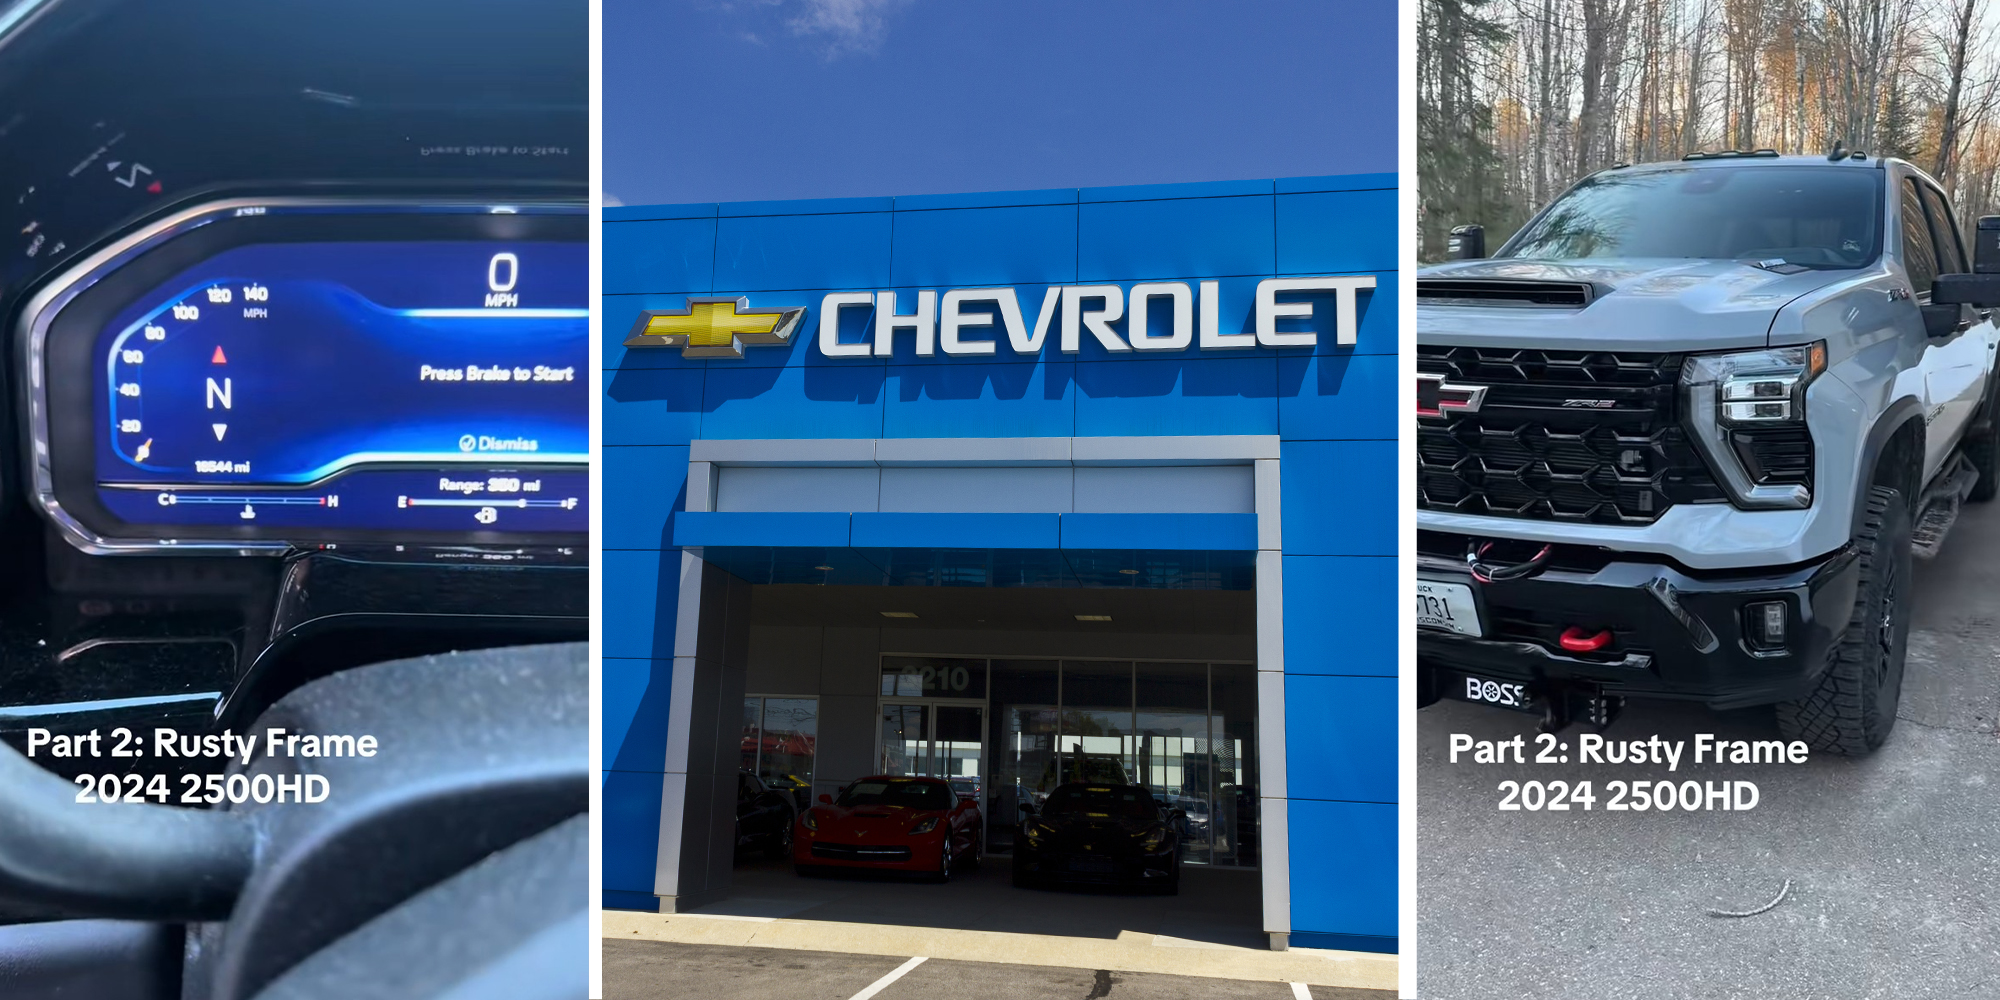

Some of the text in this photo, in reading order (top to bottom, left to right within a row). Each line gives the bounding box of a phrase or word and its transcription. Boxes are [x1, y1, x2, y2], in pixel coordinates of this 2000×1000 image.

[489, 252, 518, 291] 0
[207, 288, 232, 303] 120
[243, 286, 269, 301] 140
[485, 293, 519, 307] MPH
[172, 305, 199, 320] 100
[243, 308, 268, 318] MPH
[818, 275, 1378, 359] CHEVROLET
[144, 325, 166, 340] 80
[420, 364, 574, 381] Press Brake to Start
[119, 383, 141, 397] 40
[206, 377, 232, 409] N
[1562, 399, 1616, 408] ZR2
[121, 419, 142, 433] 20
[478, 435, 539, 451] Dismiss
[234, 460, 251, 473] mi
[439, 477, 485, 495] Range:
[523, 479, 541, 492] mi
[327, 495, 339, 508] H
[397, 495, 408, 508] E
[567, 497, 578, 510] F
[1417, 594, 1455, 621] 731
